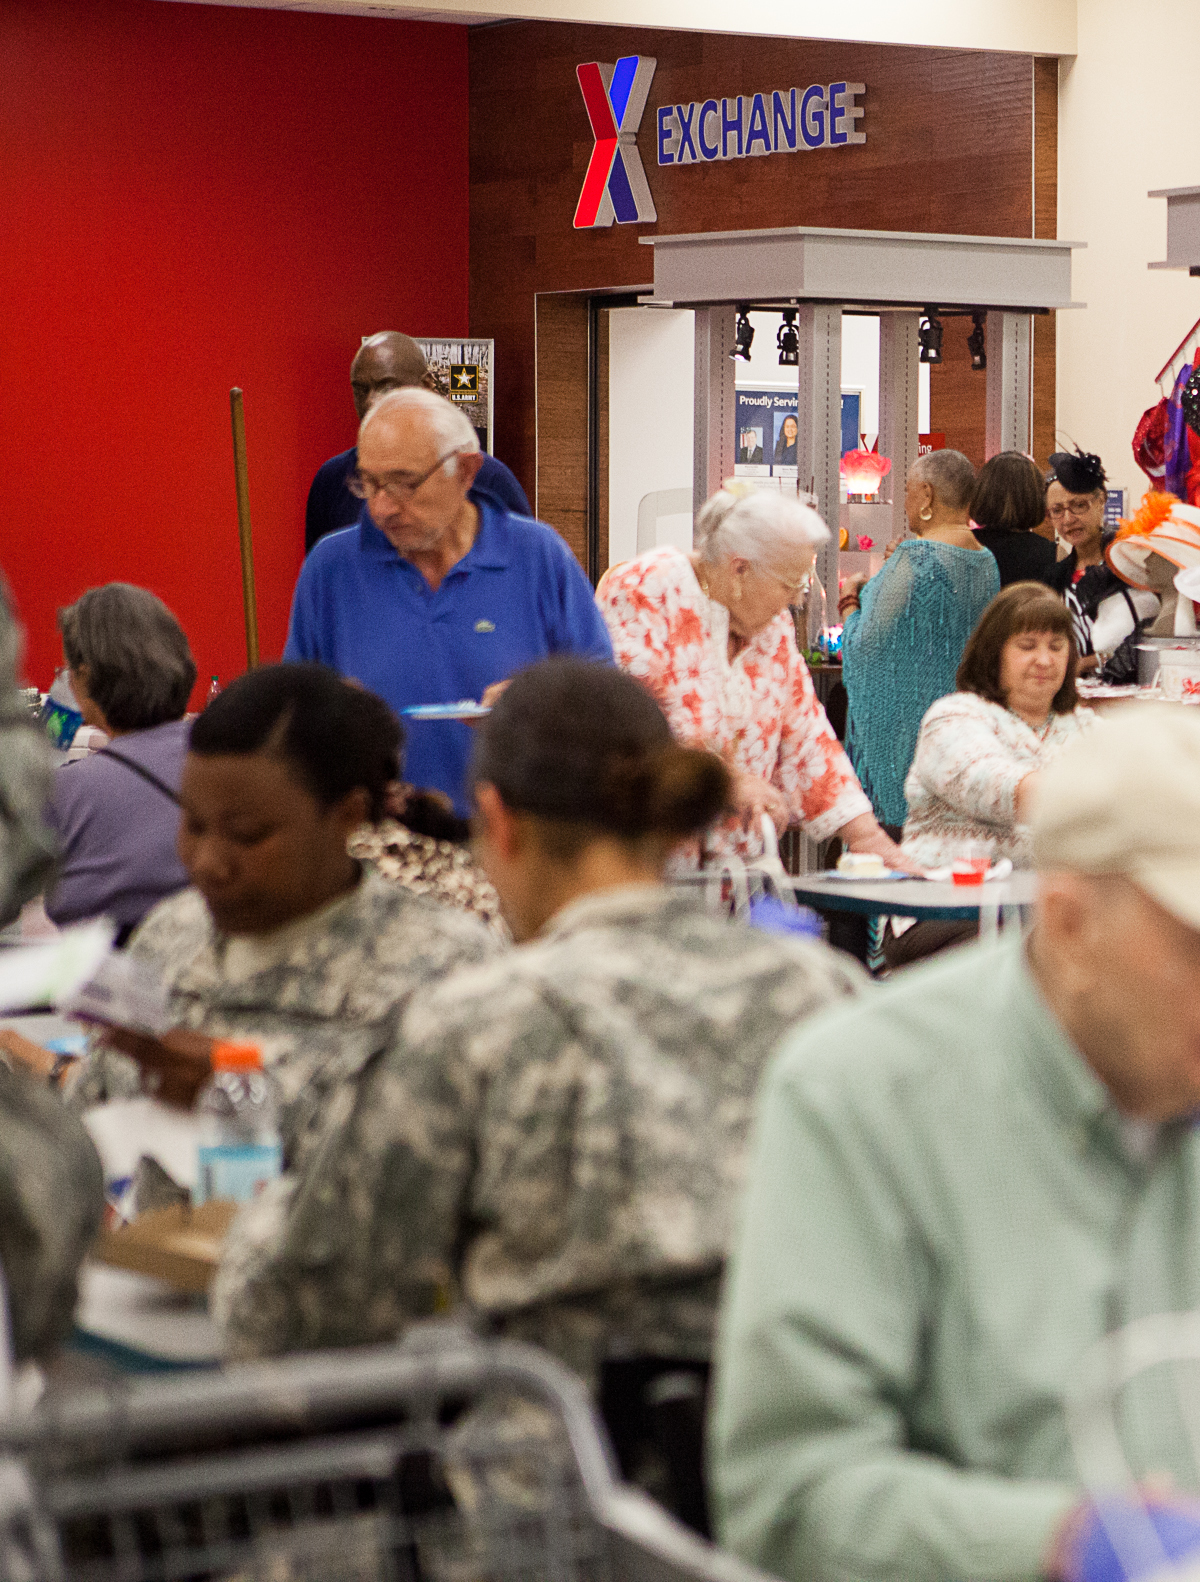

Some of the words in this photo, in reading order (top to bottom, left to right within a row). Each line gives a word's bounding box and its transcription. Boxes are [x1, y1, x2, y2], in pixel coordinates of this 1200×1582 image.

[657, 81, 855, 166] EXCHANGE
[739, 395, 772, 409] Proudly
[773, 396, 799, 407] Servin
